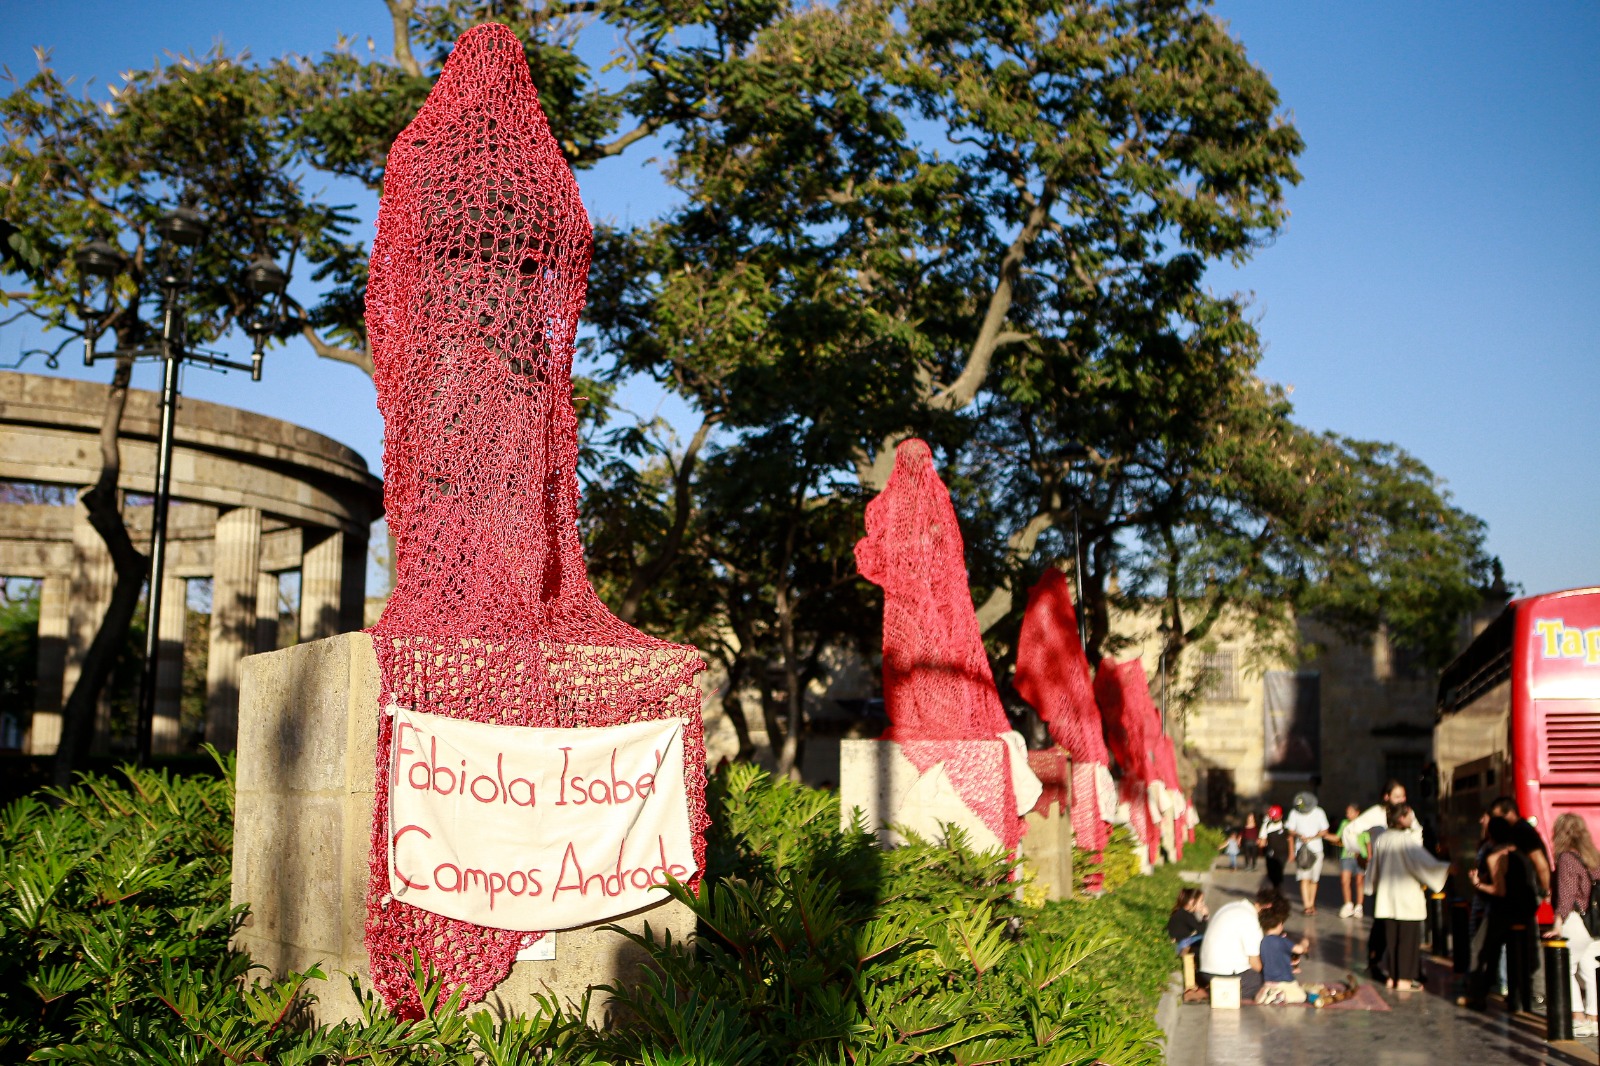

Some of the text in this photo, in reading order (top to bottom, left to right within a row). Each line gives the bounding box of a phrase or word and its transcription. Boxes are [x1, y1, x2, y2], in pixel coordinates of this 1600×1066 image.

[395, 721, 661, 808] Fabiola Isabel
[393, 824, 689, 911] Campos Andrade
